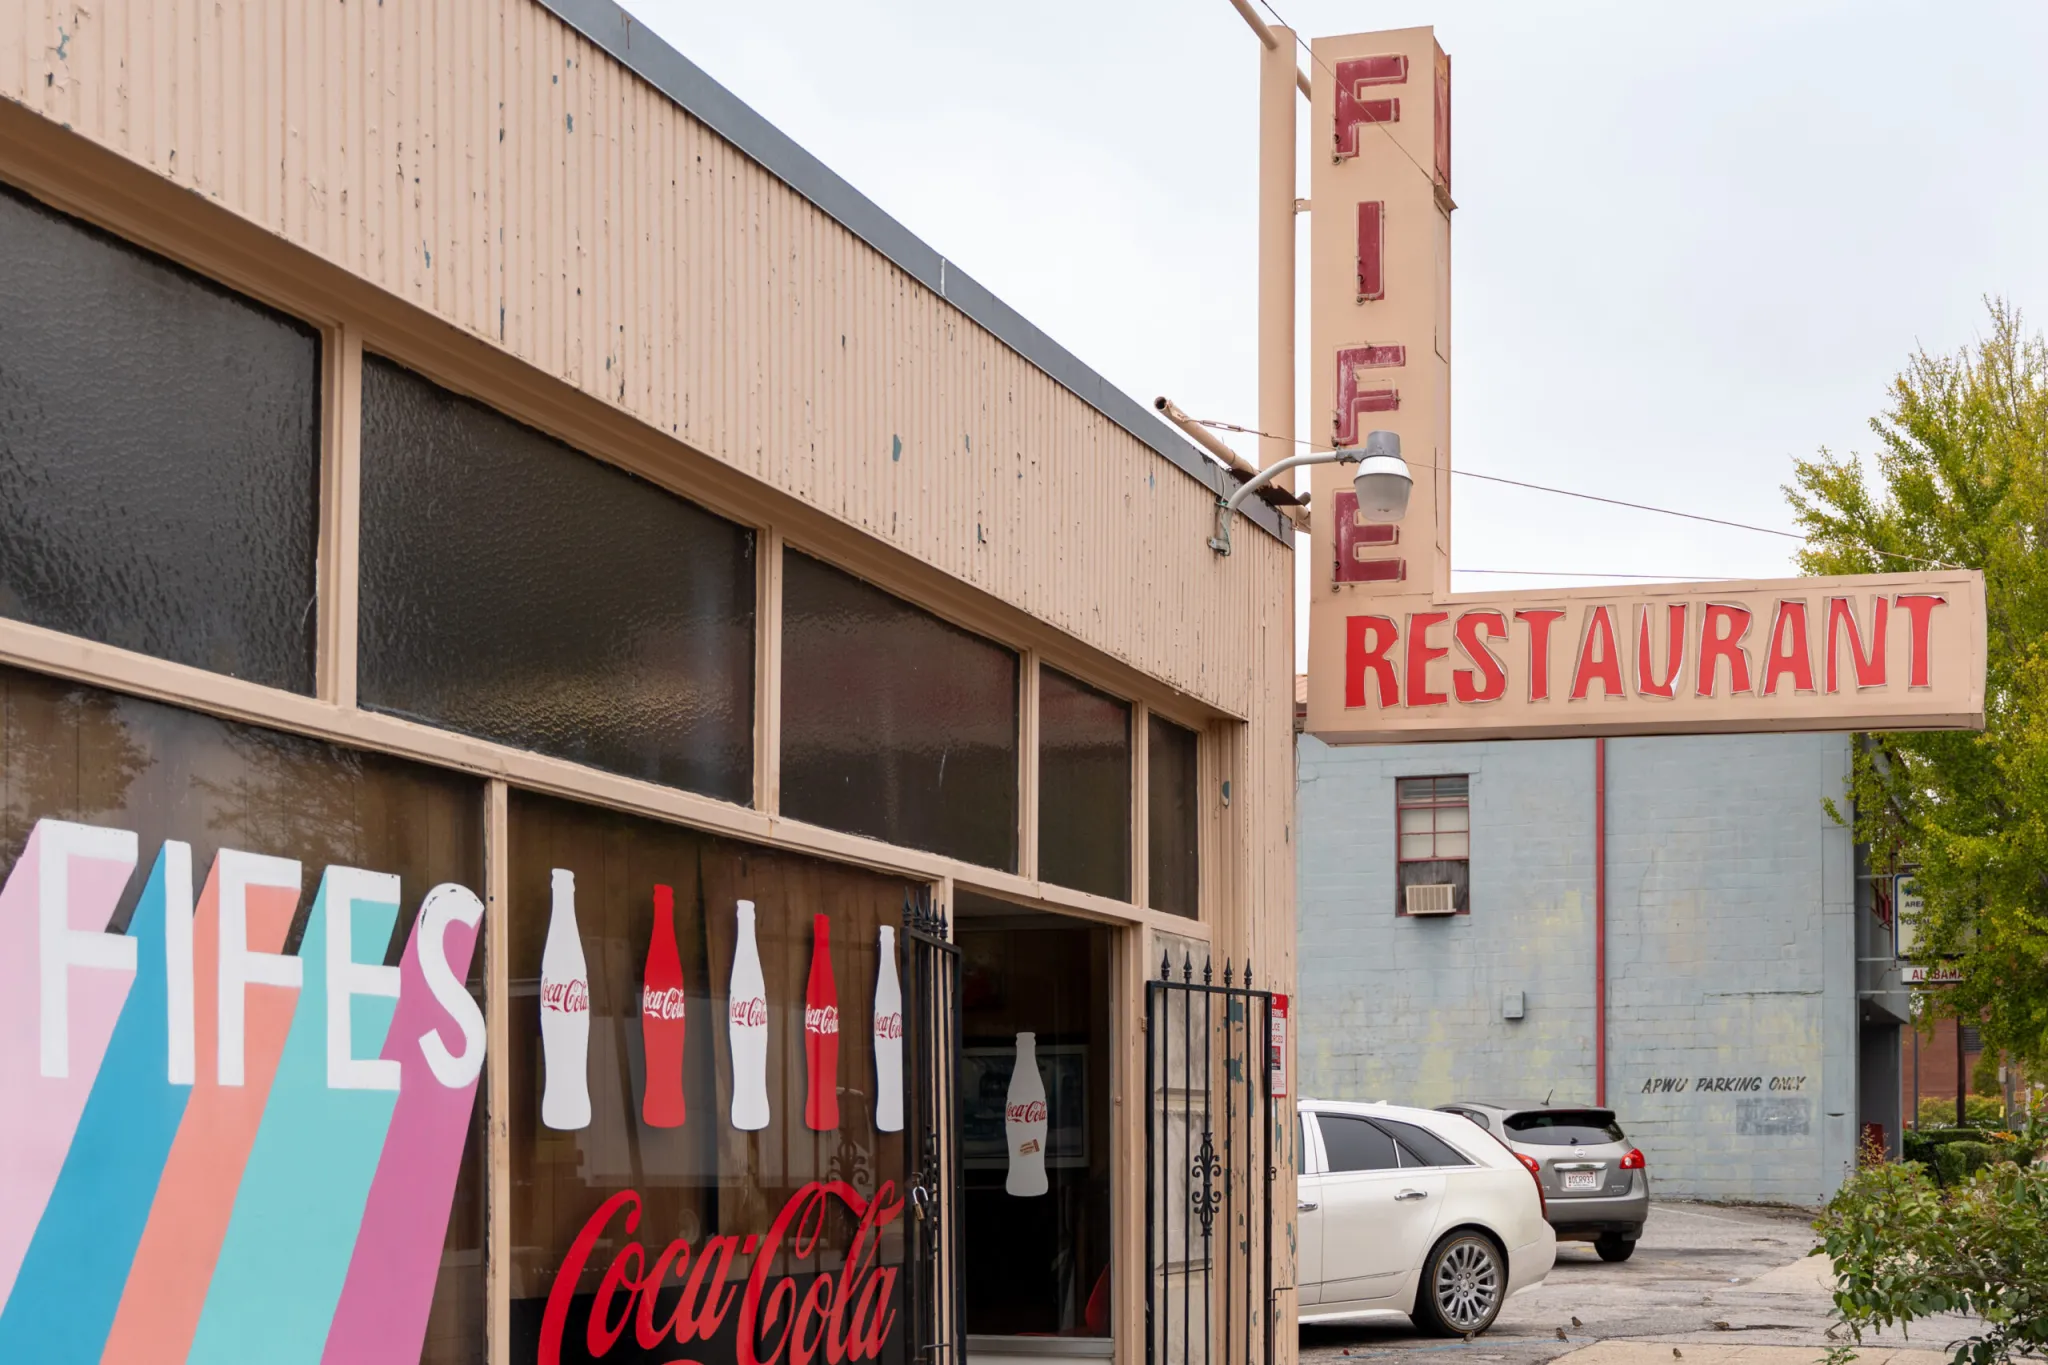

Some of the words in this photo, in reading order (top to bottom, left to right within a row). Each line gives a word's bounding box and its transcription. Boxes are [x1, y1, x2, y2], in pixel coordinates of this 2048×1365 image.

[1343, 594, 1951, 710] RESTAURANT
[40, 818, 487, 1090] FIFES
[541, 977, 589, 1013] Coca-Cola
[643, 984, 685, 1020] Coca-Cola
[1641, 1077, 1688, 1094] APWU
[1695, 1076, 1763, 1093] PARKING
[1768, 1075, 1807, 1092] ONLY
[1006, 1100, 1047, 1124] Coca-Cola
[537, 1180, 905, 1365] Coca-Cola
